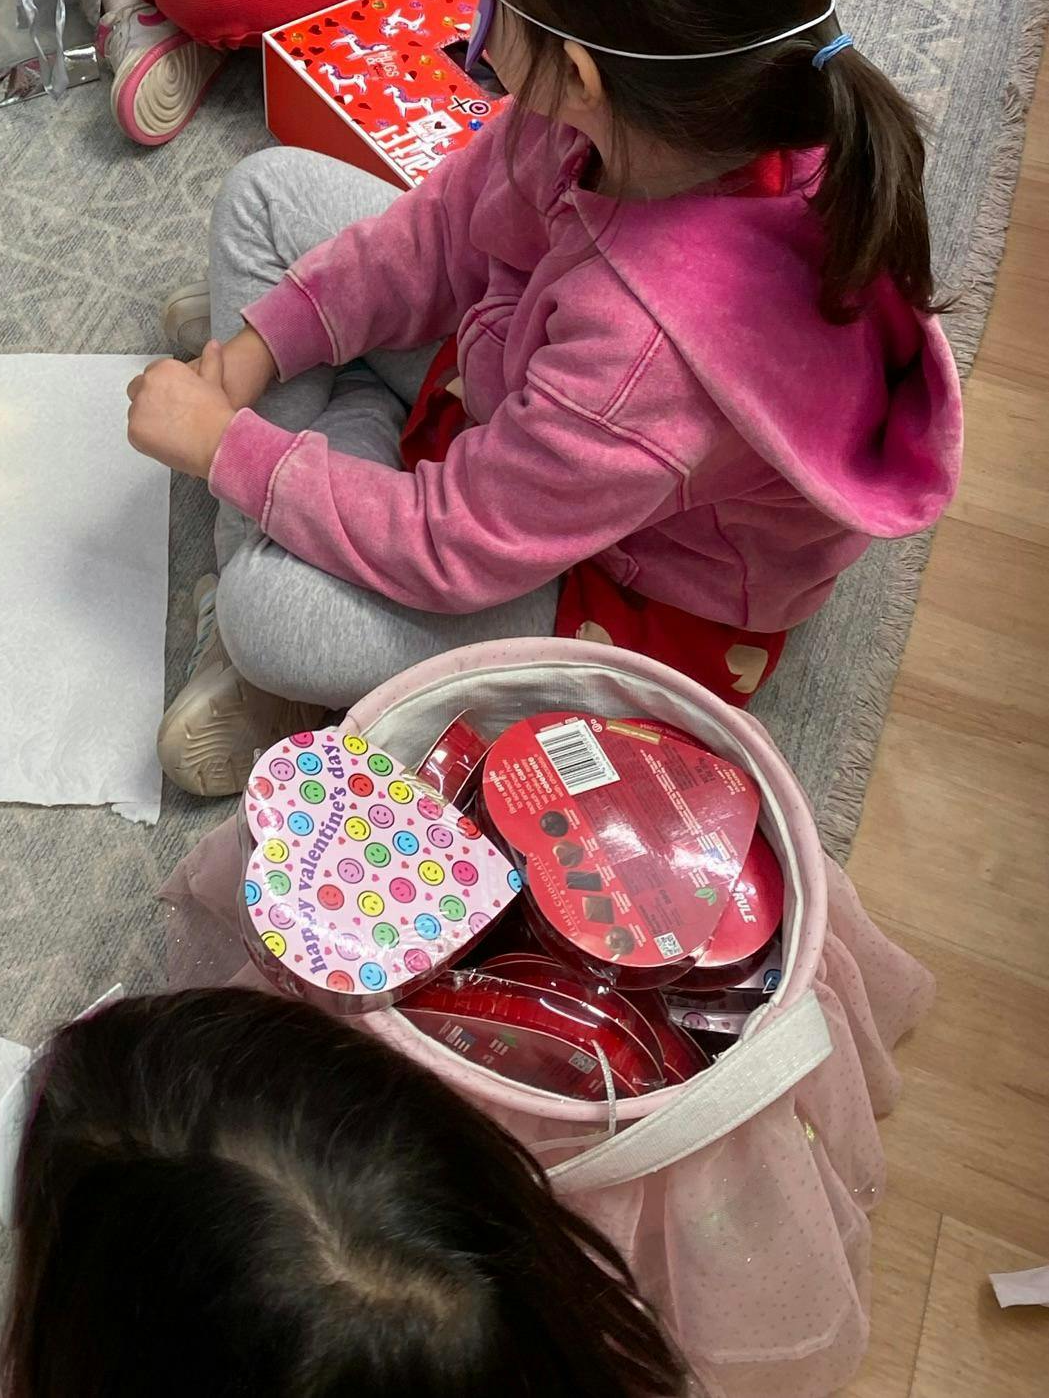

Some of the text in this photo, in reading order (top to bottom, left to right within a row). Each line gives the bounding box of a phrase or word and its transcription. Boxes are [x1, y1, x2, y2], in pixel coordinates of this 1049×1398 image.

[321, 743, 345, 779] day
[528, 756, 553, 794] celebrate
[488, 770, 505, 793] smile
